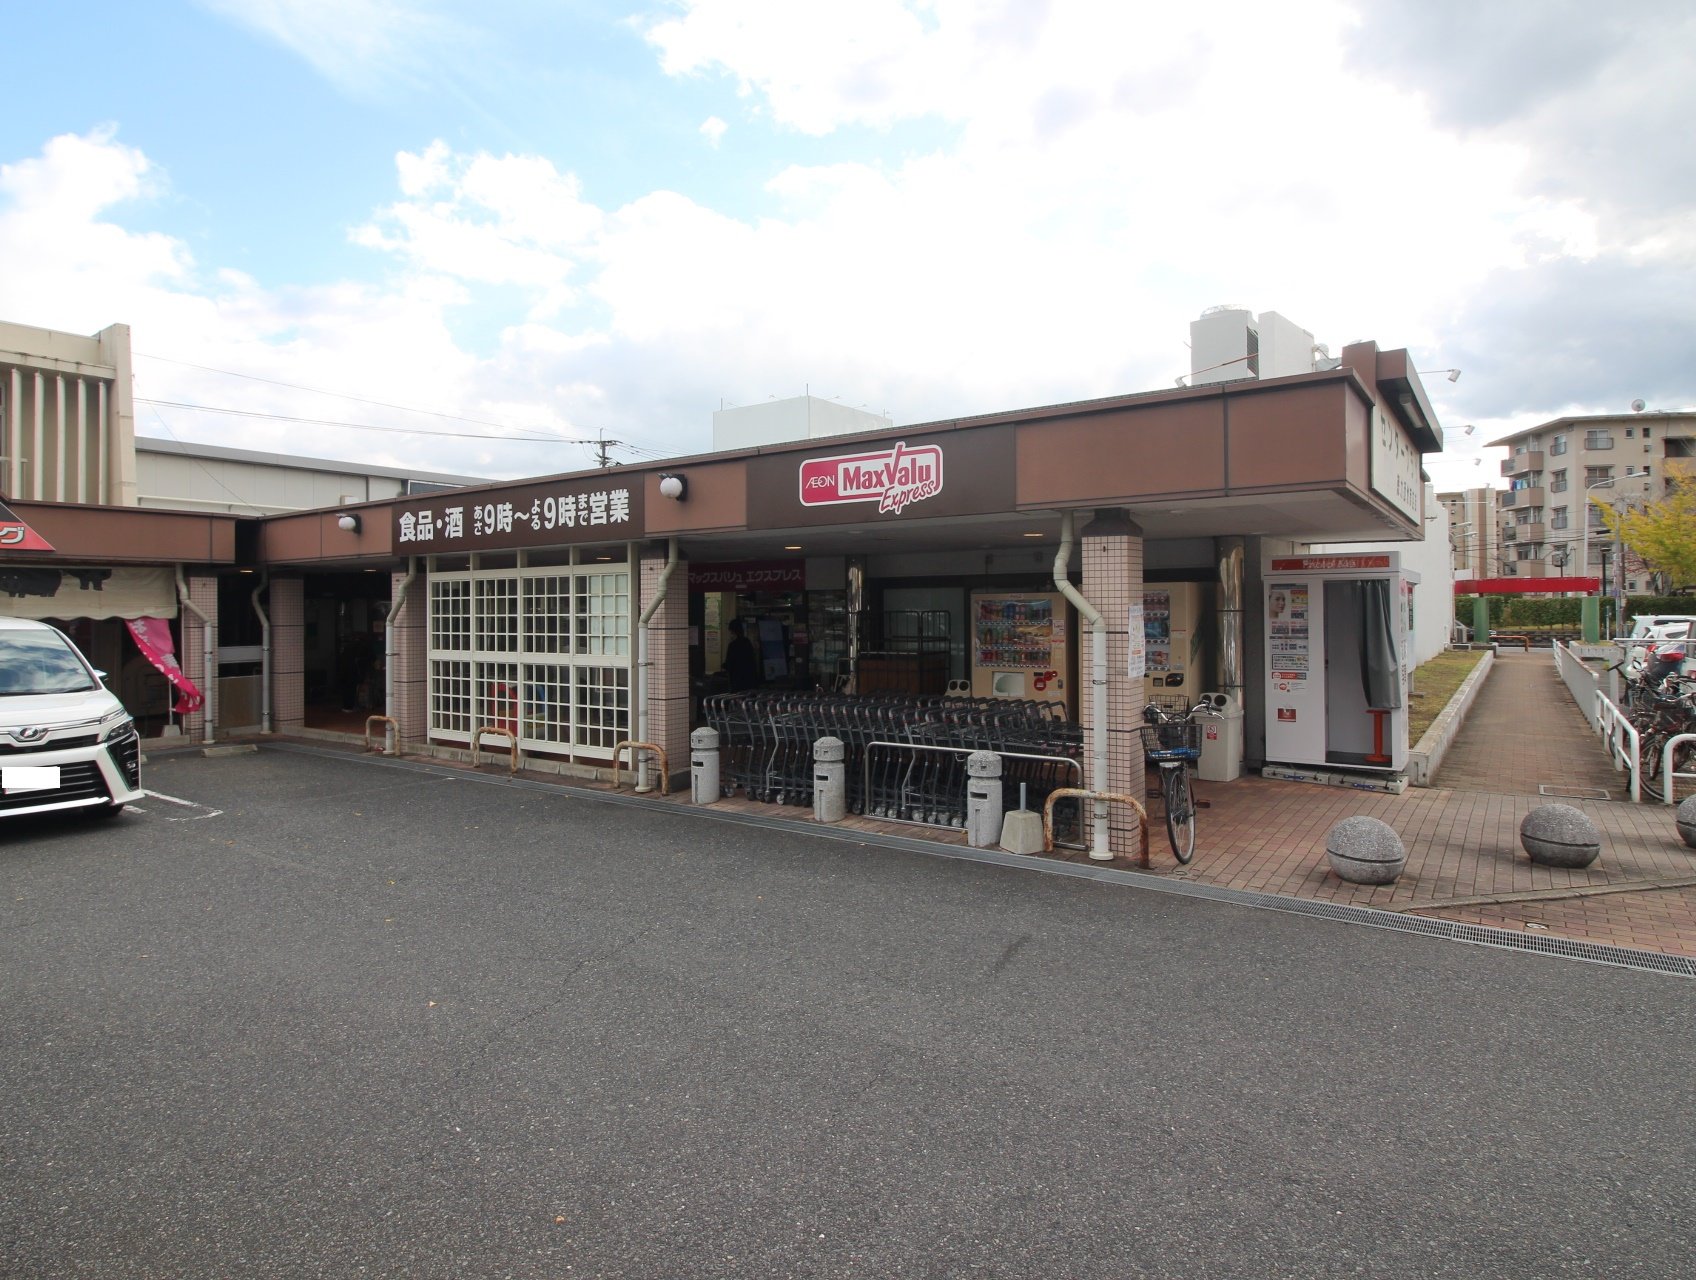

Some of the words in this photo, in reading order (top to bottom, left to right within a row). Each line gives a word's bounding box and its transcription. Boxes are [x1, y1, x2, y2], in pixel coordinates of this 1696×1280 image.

[842, 444, 932, 491] MaxValu
[881, 480, 935, 512] Express
[399, 506, 464, 542] 食品・酒
